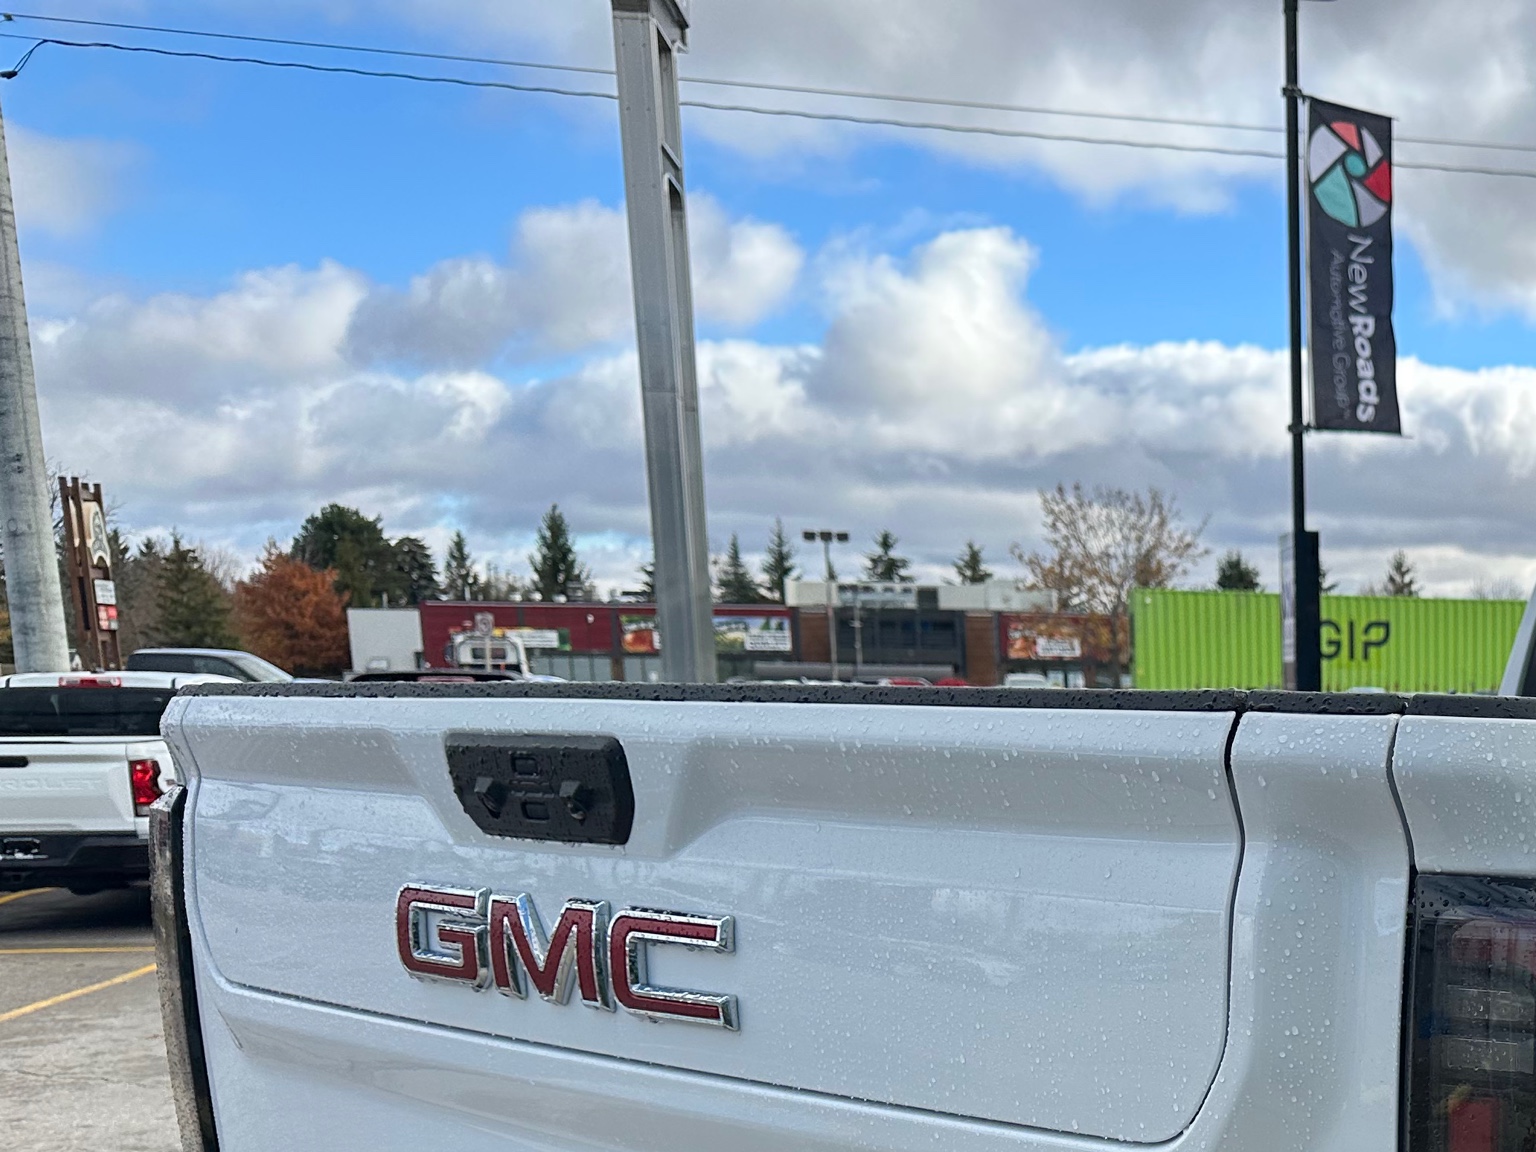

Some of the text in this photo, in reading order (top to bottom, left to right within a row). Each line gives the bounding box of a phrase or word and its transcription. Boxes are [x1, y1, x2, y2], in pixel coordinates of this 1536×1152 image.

[1330, 248, 1351, 409] Automotive Group
[1347, 232, 1381, 423] NewRoads
[1319, 619, 1391, 661] GIP
[395, 882, 740, 1031] GMC
